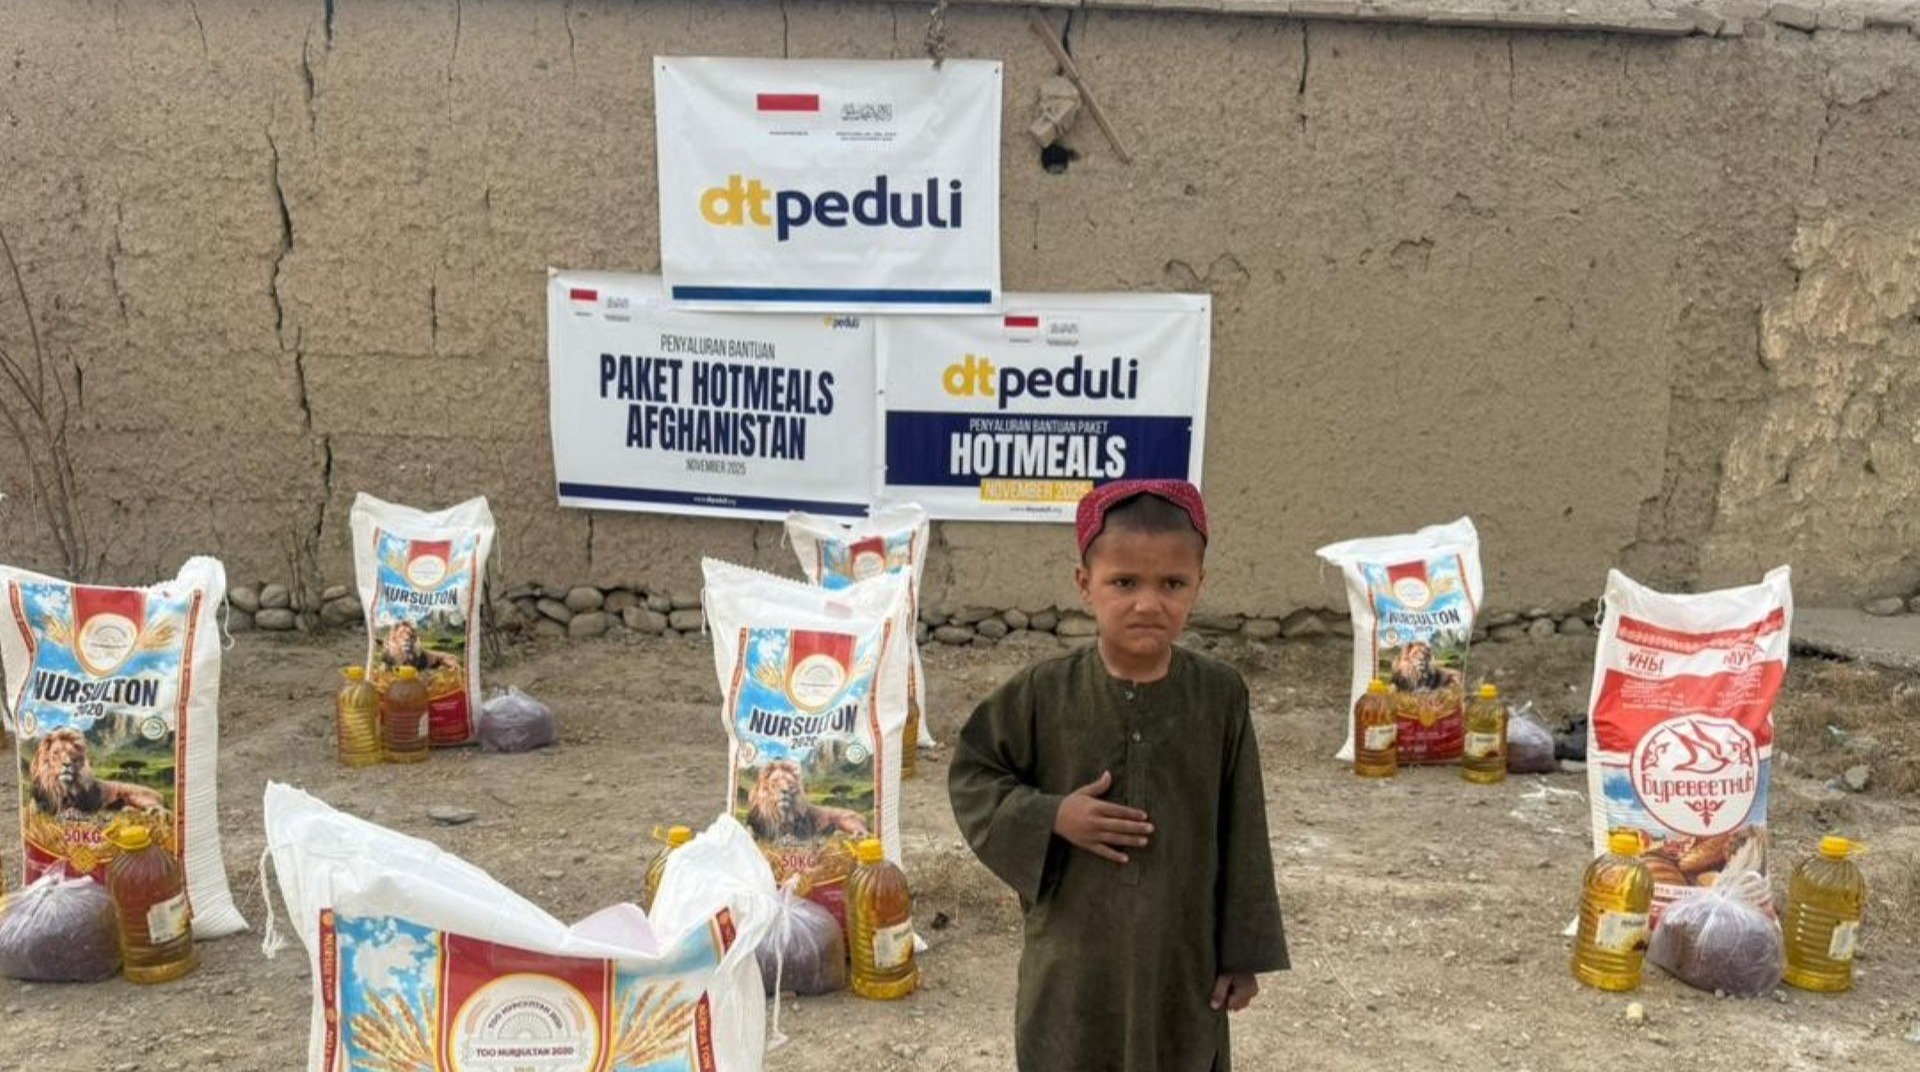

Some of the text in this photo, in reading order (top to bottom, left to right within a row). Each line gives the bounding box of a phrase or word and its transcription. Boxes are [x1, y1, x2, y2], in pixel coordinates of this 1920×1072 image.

[660, 334, 775, 360] PENYALURAN BANTUAN
[600, 354, 835, 415] PAKET HOTMEALS
[626, 404, 806, 460] AFGHANISTAN
[970, 418, 1108, 434] PENYALURAN BANTUAN PAKET
[686, 459, 747, 475] NOVEMBER 2025
[950, 433, 1127, 478] HOTMEALS
[983, 480, 1050, 499] NOVEMBER
